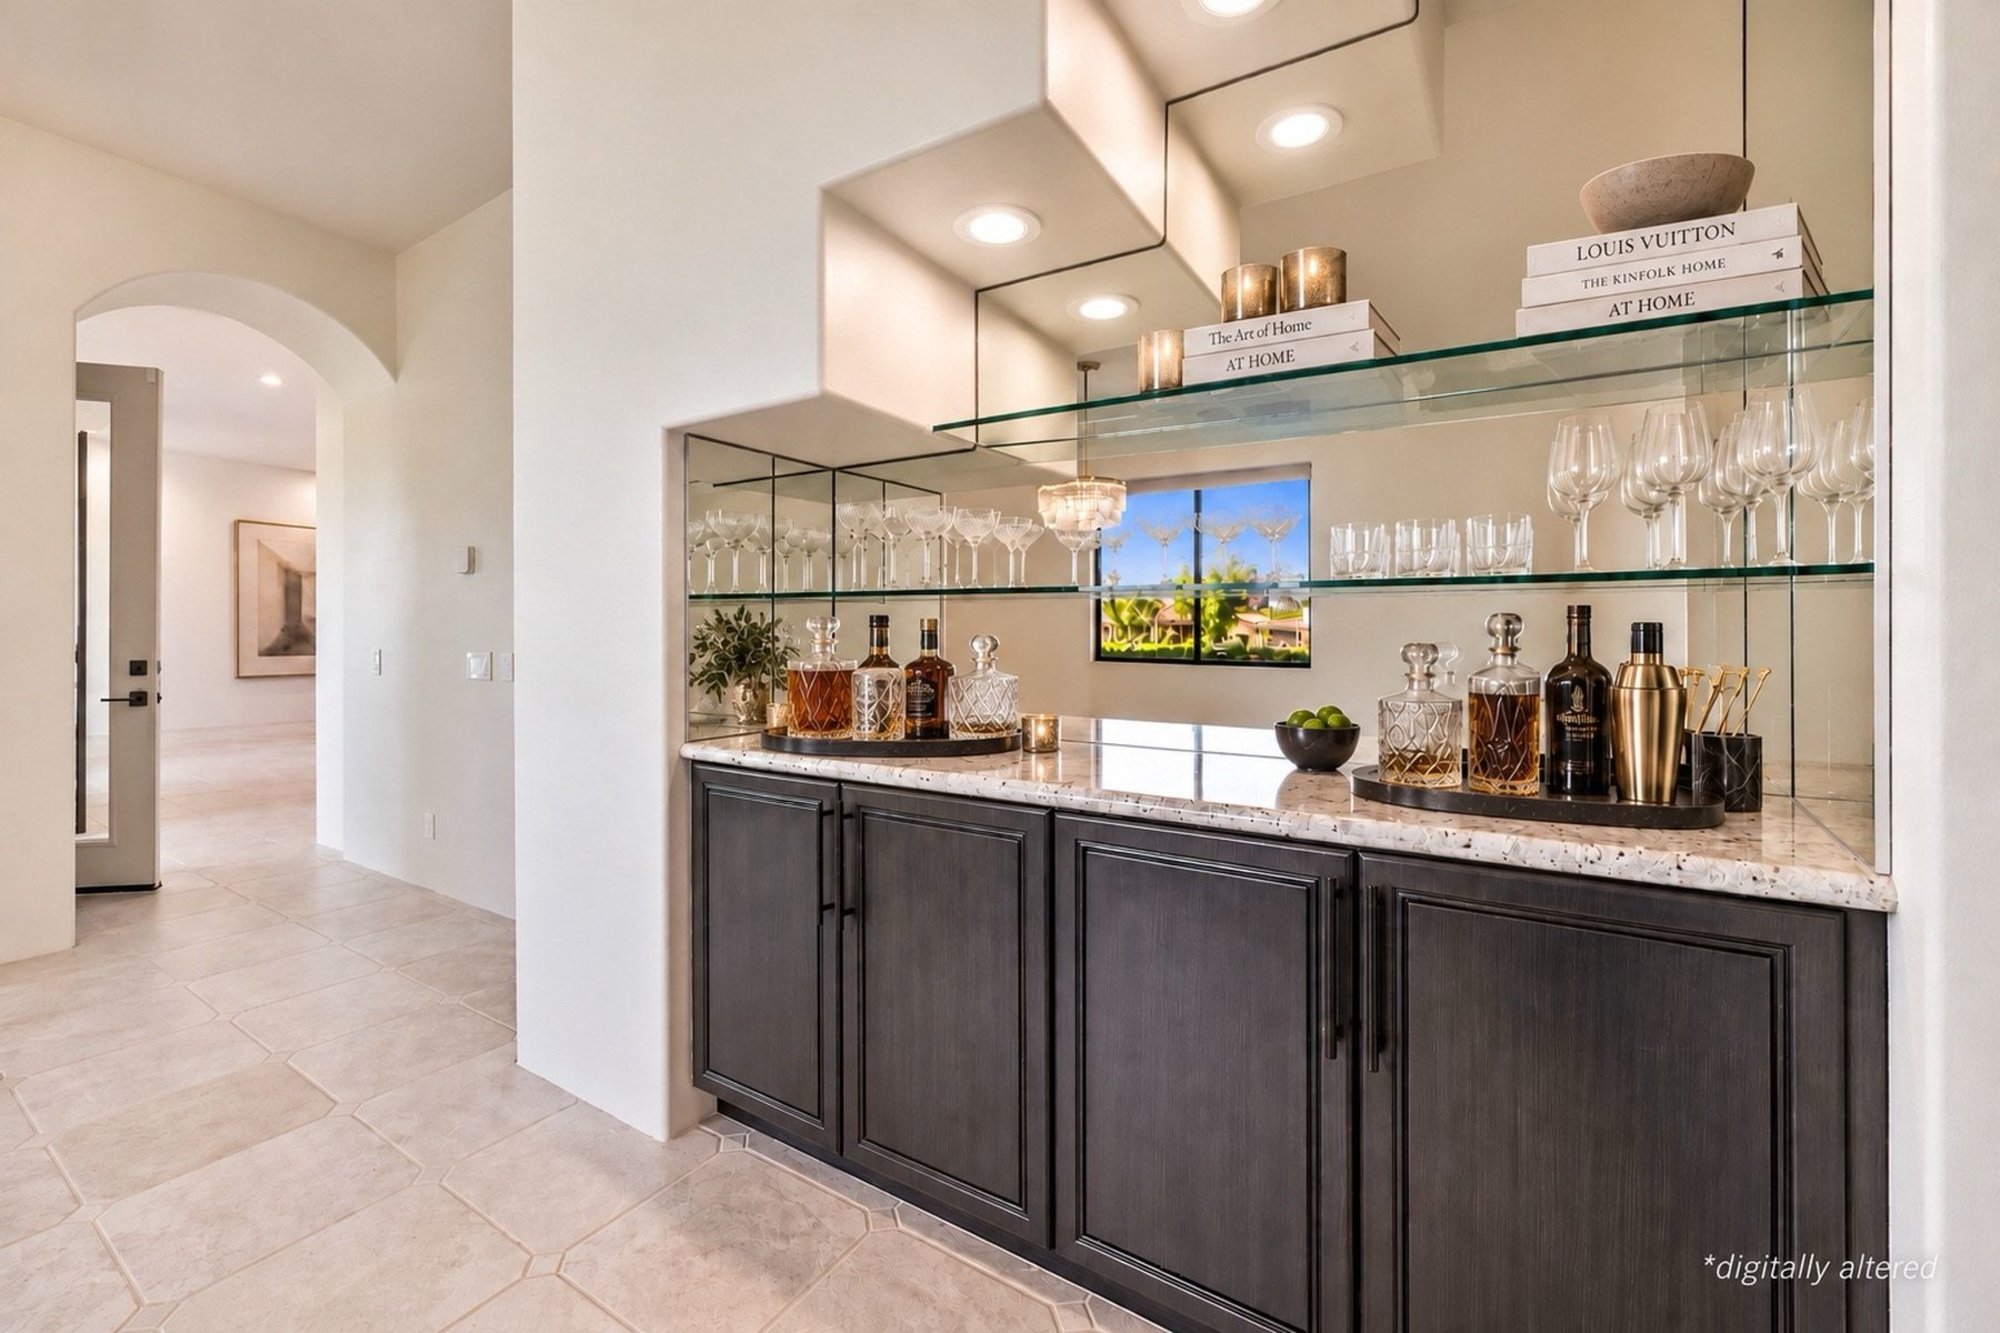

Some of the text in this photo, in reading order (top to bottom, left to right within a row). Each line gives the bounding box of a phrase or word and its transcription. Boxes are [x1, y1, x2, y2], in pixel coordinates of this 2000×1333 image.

[1577, 221, 1736, 261] LOUIS VUITTON
[1581, 257, 1727, 290] THE KINFOLK HOME
[1608, 291, 1696, 318] AT HOME
[1208, 319, 1312, 346] The Art of Home
[1226, 349, 1296, 372] AT HOME
